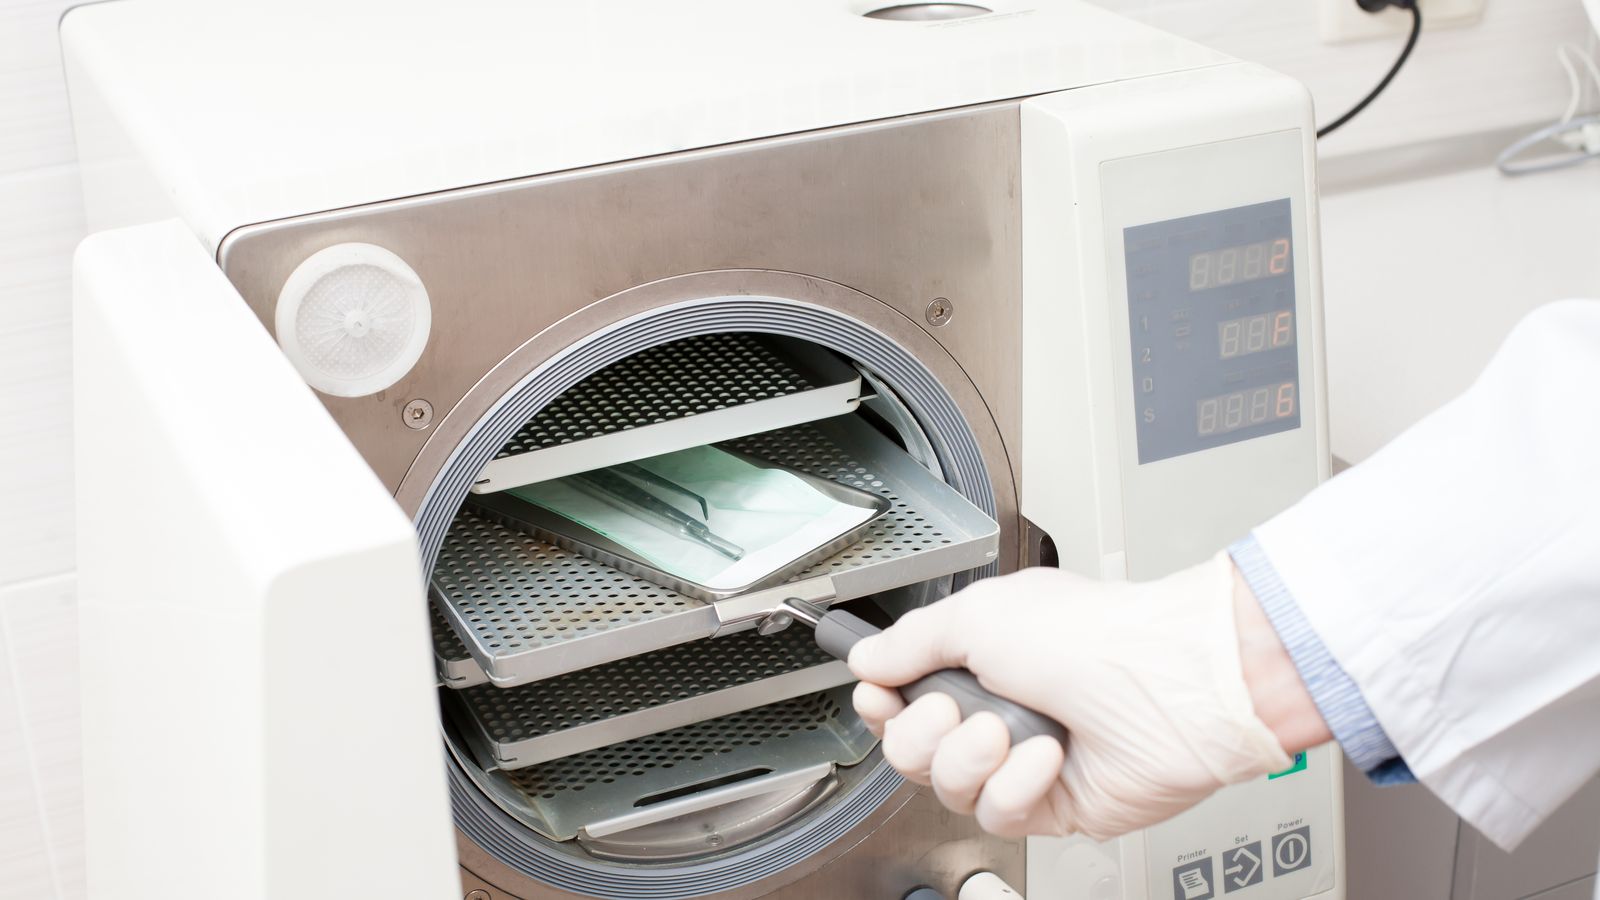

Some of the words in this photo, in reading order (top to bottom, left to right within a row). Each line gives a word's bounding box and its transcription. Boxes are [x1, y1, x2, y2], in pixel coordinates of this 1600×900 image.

[1142, 347, 1152, 363] 2
[1143, 407, 1156, 424] S
[1277, 818, 1303, 830] Power
[1234, 834, 1249, 844] Set
[1177, 848, 1207, 862] Printer
